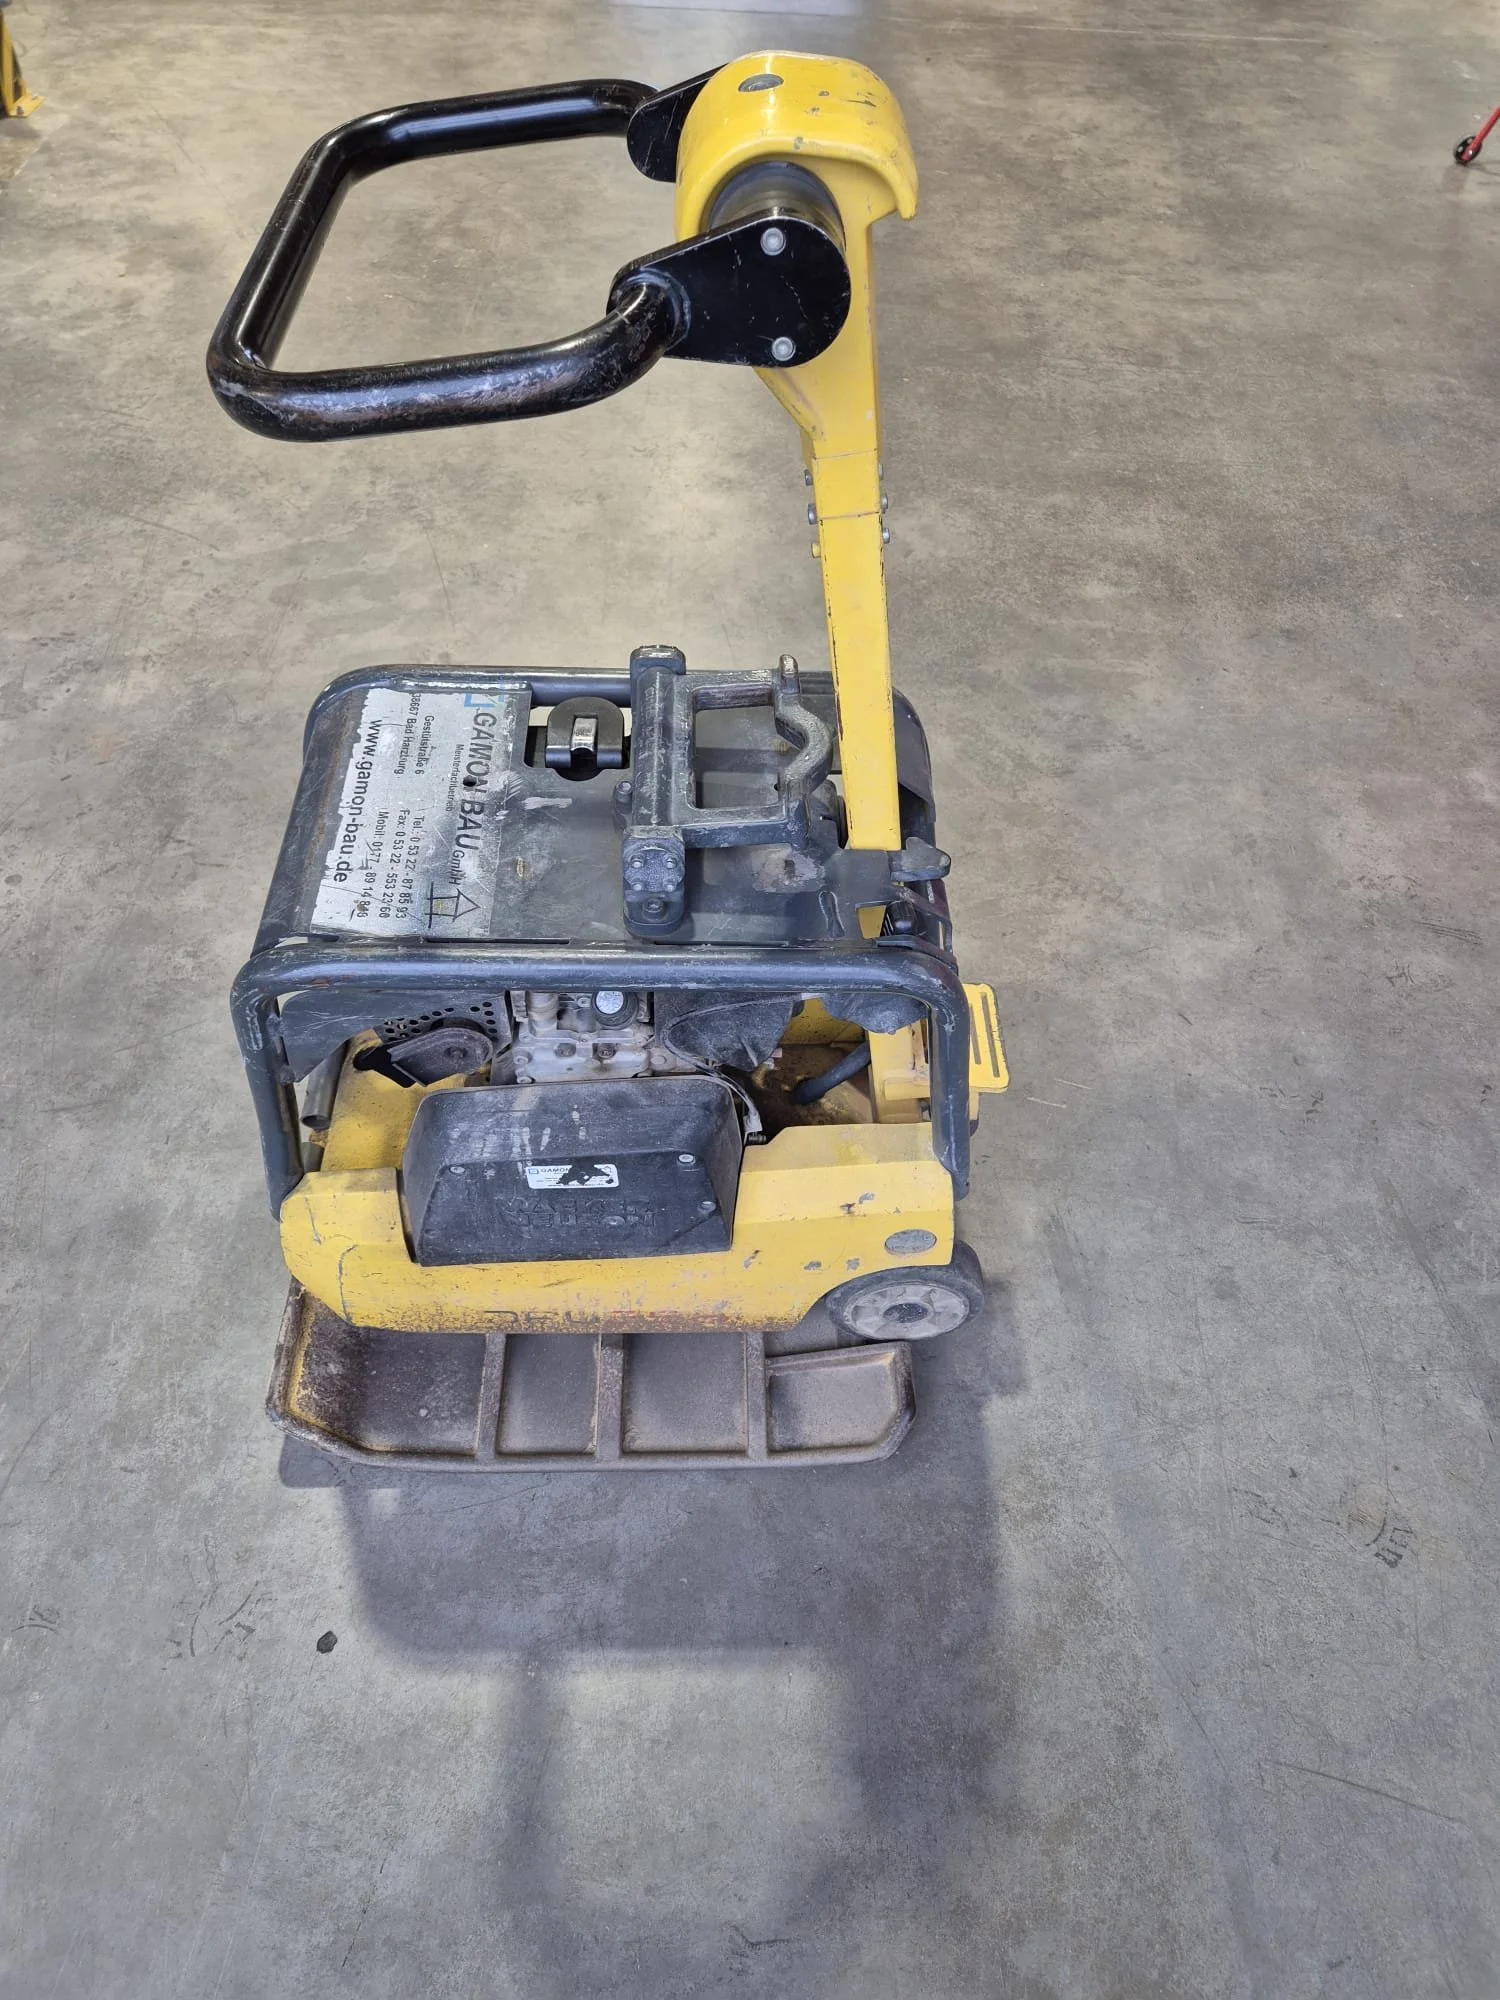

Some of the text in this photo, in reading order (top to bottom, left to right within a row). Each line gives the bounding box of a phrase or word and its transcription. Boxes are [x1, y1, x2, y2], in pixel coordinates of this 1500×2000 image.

[393, 693, 422, 775] 38667 Bad Harzburg
[416, 715, 435, 768] Gestütstraße
[445, 743, 465, 811] Meisterfachbetrieb
[333, 719, 383, 883] www.gamon-bau.de
[449, 712, 497, 885] GAMON BAU GmbH
[373, 811, 390, 839] Mobil:
[397, 809, 410, 829] Fax:
[411, 815, 425, 834] Tel.:
[369, 841, 384, 863] 0177
[392, 839, 405, 850] 53
[407, 845, 419, 856] 53
[389, 852, 402, 864] 22
[405, 859, 417, 870] 22
[364, 872, 377, 884] 89
[384, 872, 398, 890] 553
[402, 878, 414, 890] 87
[360, 886, 374, 898] 14
[398, 892, 411, 904] 85
[395, 906, 409, 919] 93
